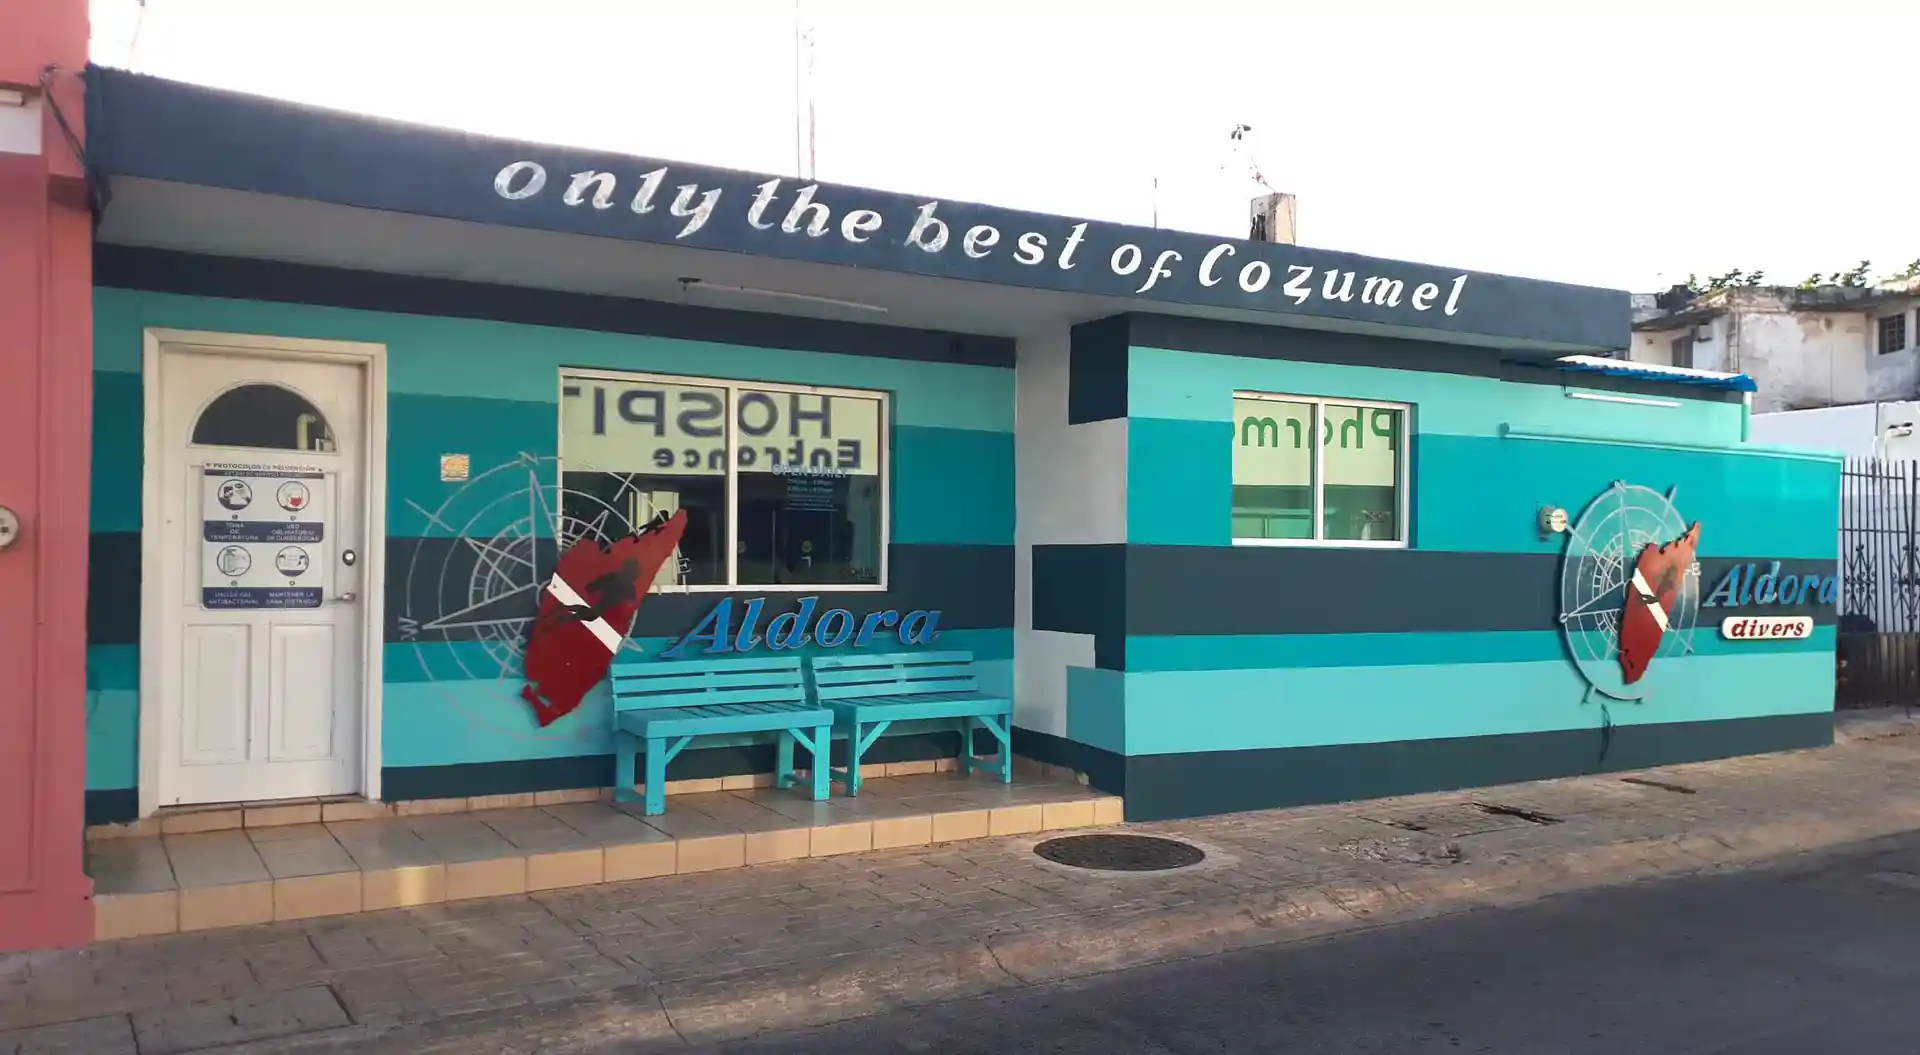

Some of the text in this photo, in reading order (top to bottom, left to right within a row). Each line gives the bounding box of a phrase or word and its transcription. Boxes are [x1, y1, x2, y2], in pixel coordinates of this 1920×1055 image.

[493, 160, 1468, 316] only the best of Cozumel
[1701, 560, 1839, 607] Aldora
[658, 595, 943, 658] Aldora
[1730, 619, 1806, 637] divers
